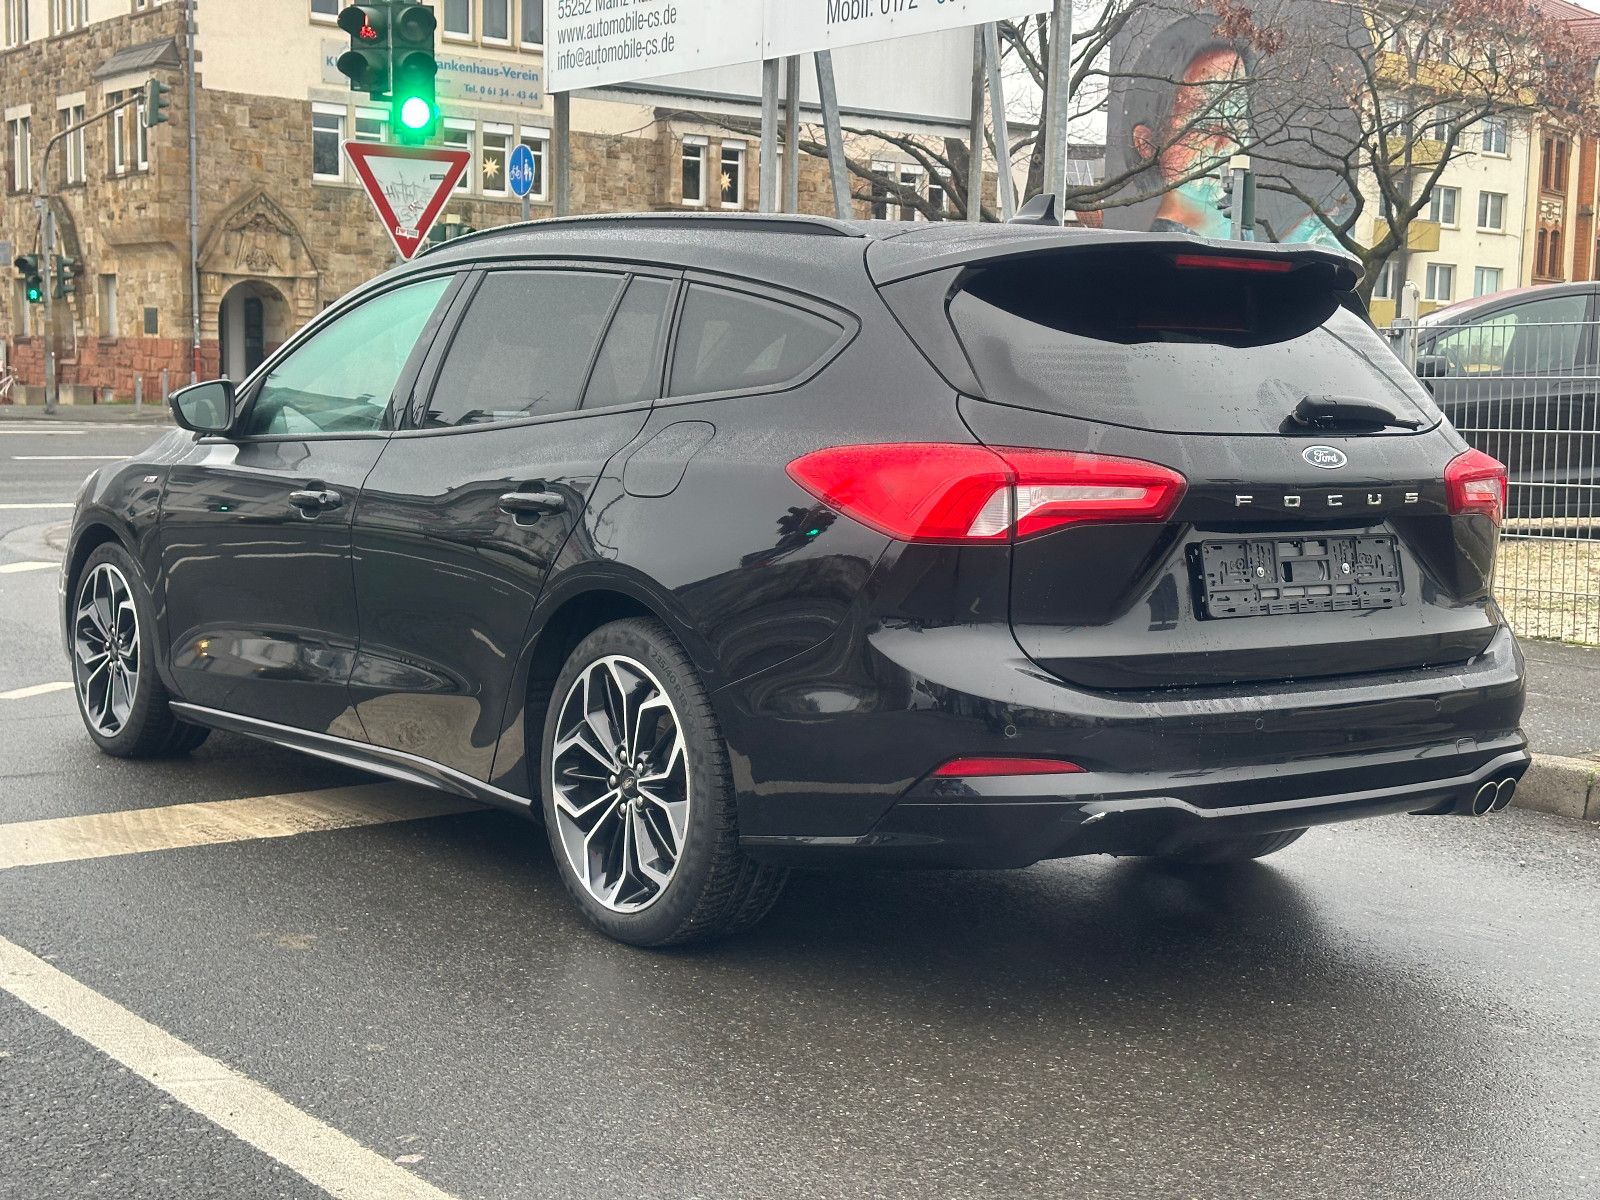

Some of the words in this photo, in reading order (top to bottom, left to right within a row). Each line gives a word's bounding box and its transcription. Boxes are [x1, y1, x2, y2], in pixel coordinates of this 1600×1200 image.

[558, 0, 591, 19] 55252
[557, 3, 677, 44] www.automobile-cs.de
[557, 32, 675, 71] info@automobile-cs.de
[436, 59, 539, 81] ankenhaus-Verein
[464, 83, 477, 93] Tel.
[480, 86, 485, 94] 0
[487, 87, 496, 95] 61
[500, 88, 509, 97] 34
[517, 90, 526, 99] 43
[528, 92, 538, 100] 44
[1235, 492, 1419, 508] FOCUS
